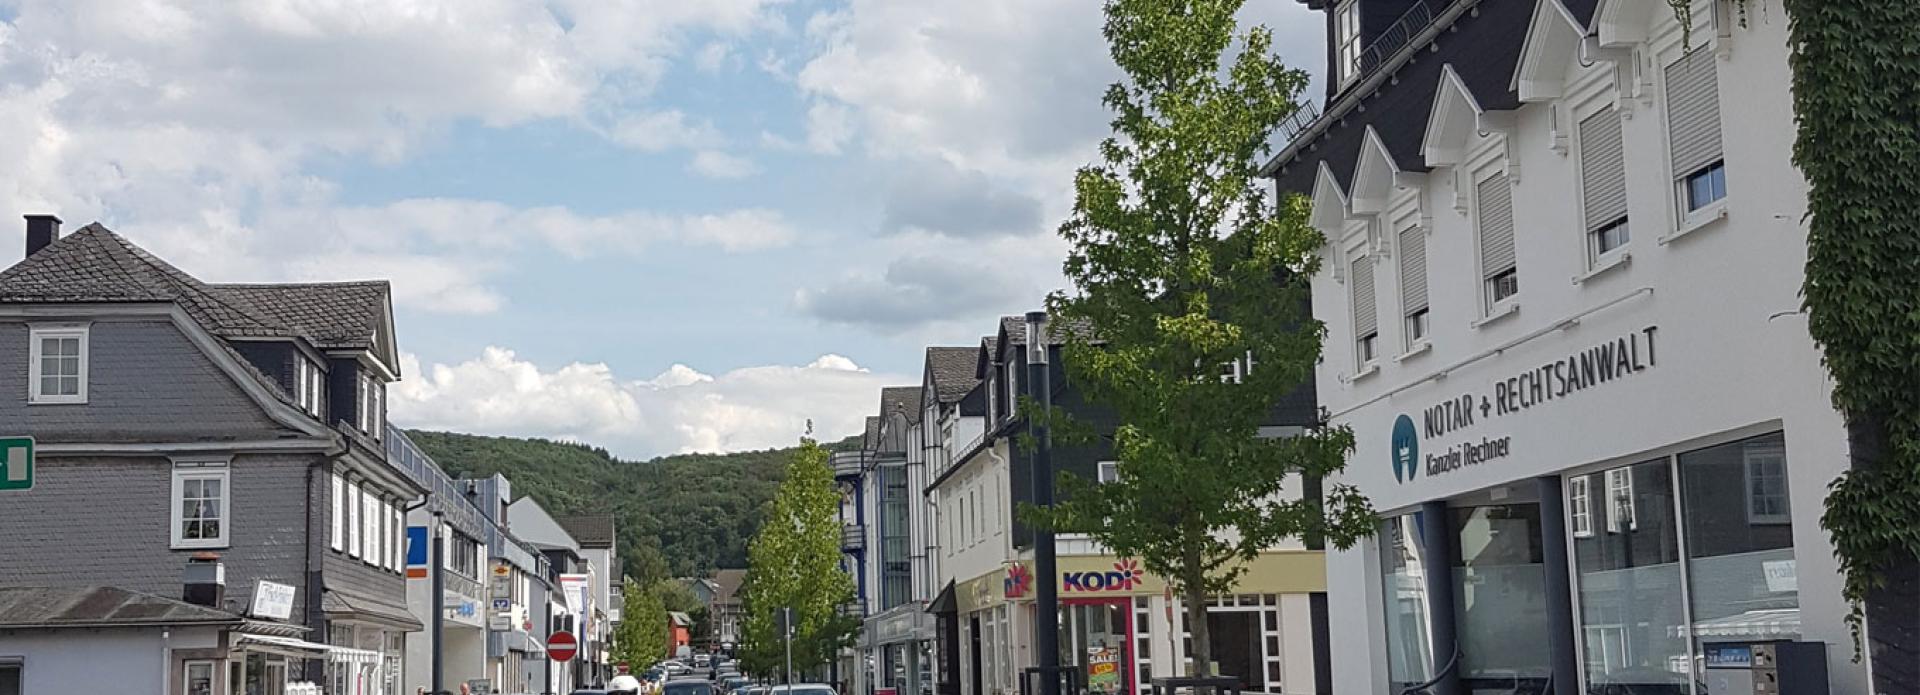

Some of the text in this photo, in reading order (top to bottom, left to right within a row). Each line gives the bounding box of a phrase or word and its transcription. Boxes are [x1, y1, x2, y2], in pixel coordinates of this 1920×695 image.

[1424, 325, 1658, 439] NOTAR + RECHTSANWALT
[1425, 436, 1511, 477] Kanzlei Rechner
